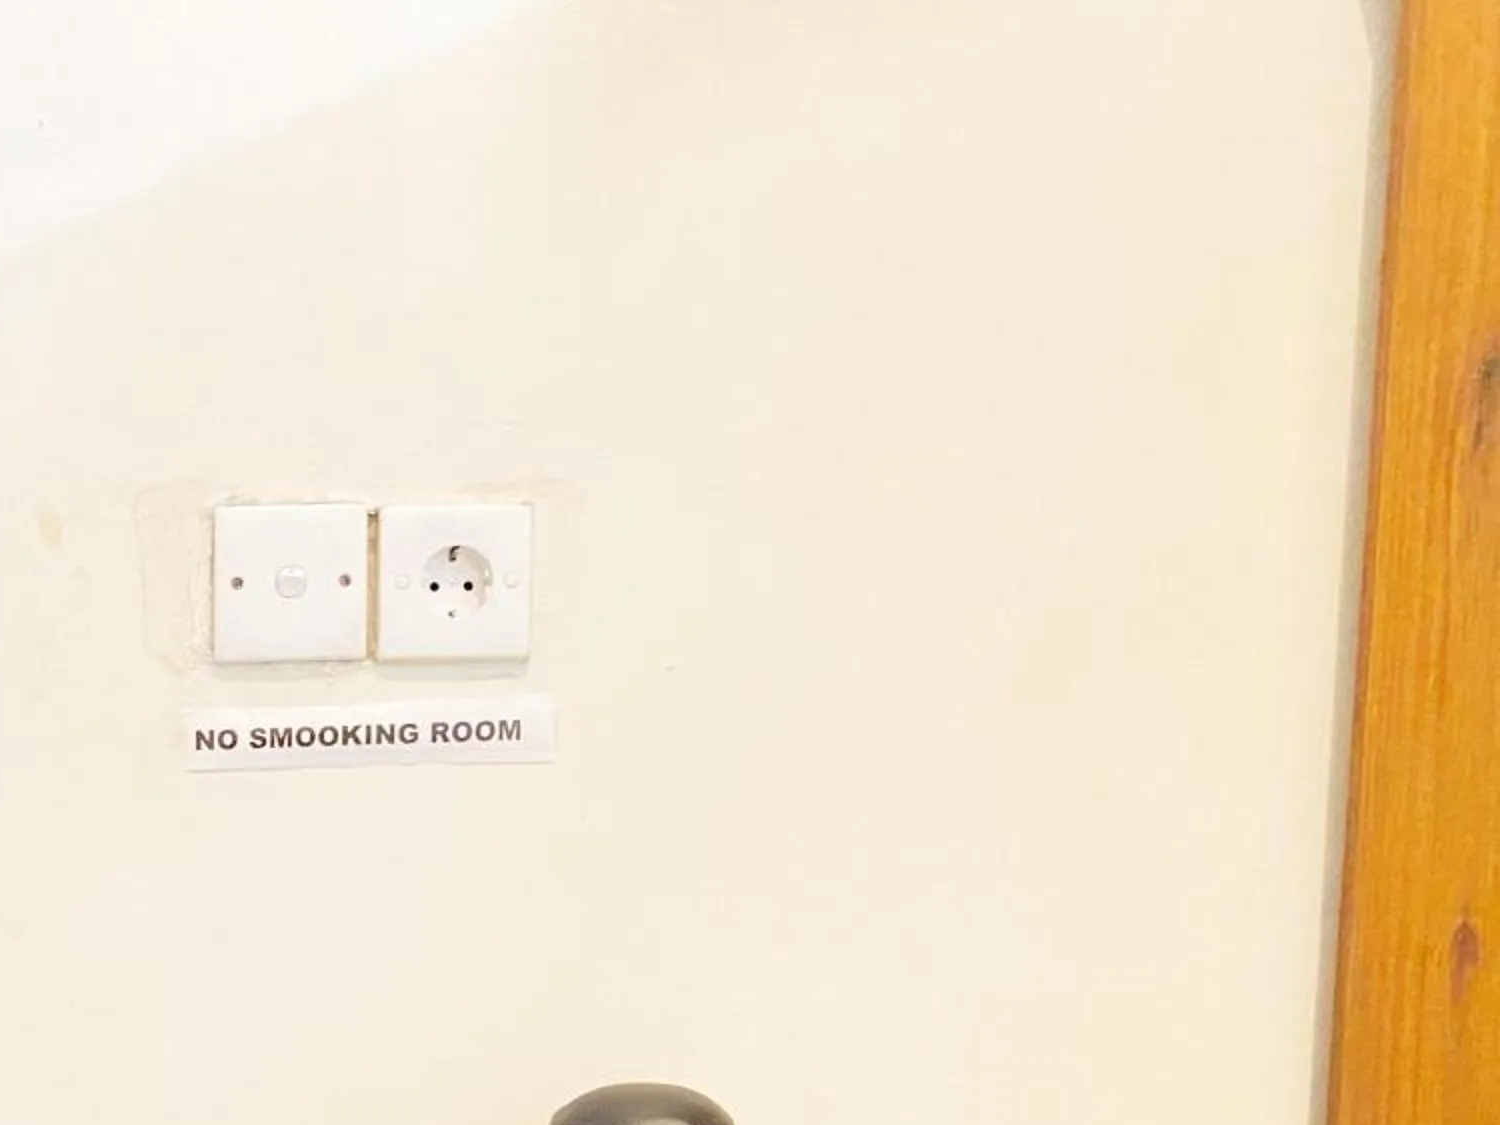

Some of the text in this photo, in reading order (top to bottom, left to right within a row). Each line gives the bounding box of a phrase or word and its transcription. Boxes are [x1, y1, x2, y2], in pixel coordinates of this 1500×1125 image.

[195, 719, 521, 751] NO SMOOKING ROOM
